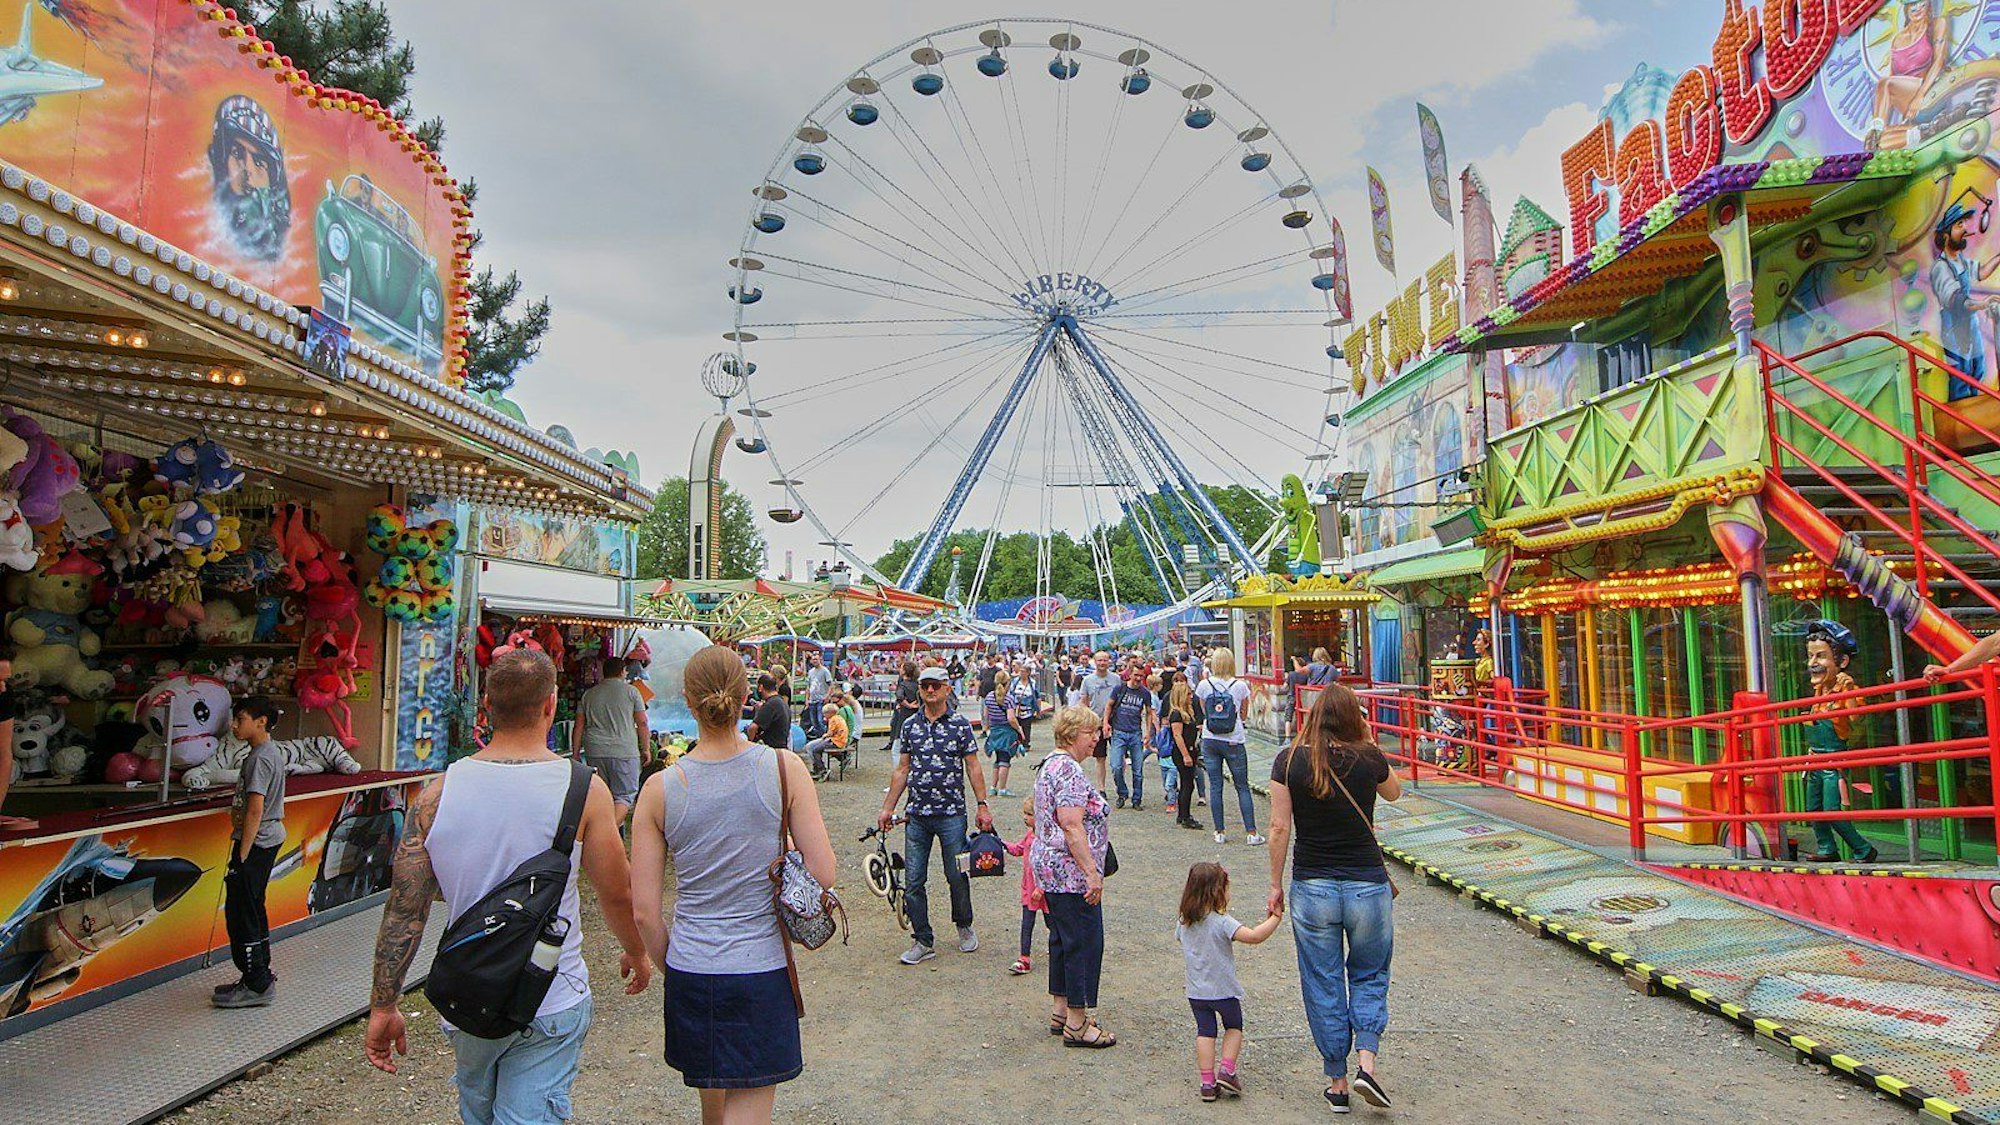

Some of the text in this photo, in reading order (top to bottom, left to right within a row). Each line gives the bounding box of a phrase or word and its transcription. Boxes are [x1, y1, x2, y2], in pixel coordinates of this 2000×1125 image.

[1010, 272, 1119, 311] LIBERTY
[1343, 249, 1461, 400] TIME
[1796, 989, 1951, 1026] DANGER
